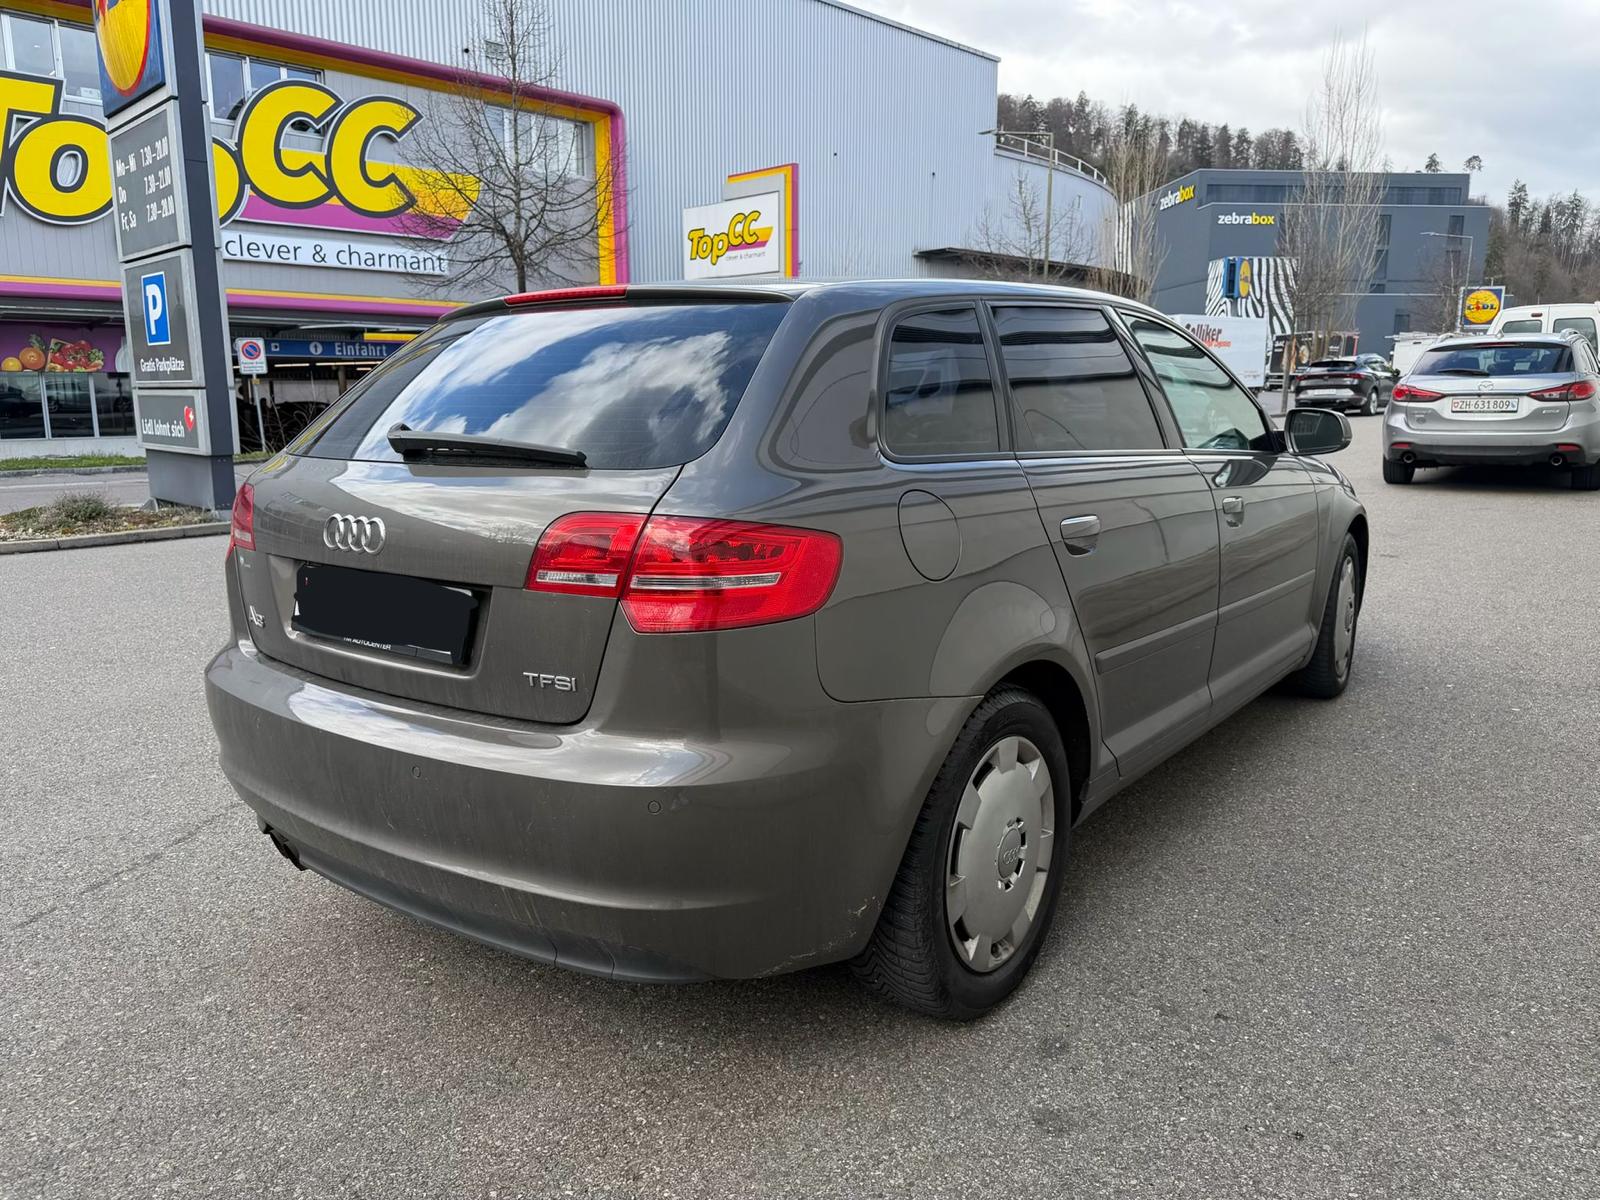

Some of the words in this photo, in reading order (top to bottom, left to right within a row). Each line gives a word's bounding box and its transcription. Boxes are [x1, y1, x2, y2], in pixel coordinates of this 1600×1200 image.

[0, 70, 424, 228] oCC
[118, 186, 127, 204] Do
[1159, 184, 1195, 211] zebrabox
[1217, 212, 1275, 225] zebrabox
[688, 210, 761, 266] TopCC
[224, 234, 302, 261] clever
[312, 244, 327, 264] &
[335, 244, 446, 273] charmant
[146, 283, 163, 336] P
[334, 342, 387, 357] Einfahrt
[140, 357, 156, 372] Gratis
[155, 356, 185, 374] Parkplätze
[1459, 401, 1471, 410] ZH
[1474, 400, 1510, 411] 631809
[141, 417, 154, 435] Lidl
[153, 418, 171, 437] lohnt
[170, 420, 185, 438] sich
[249, 605, 265, 628] A3
[522, 671, 577, 692] TFSI
